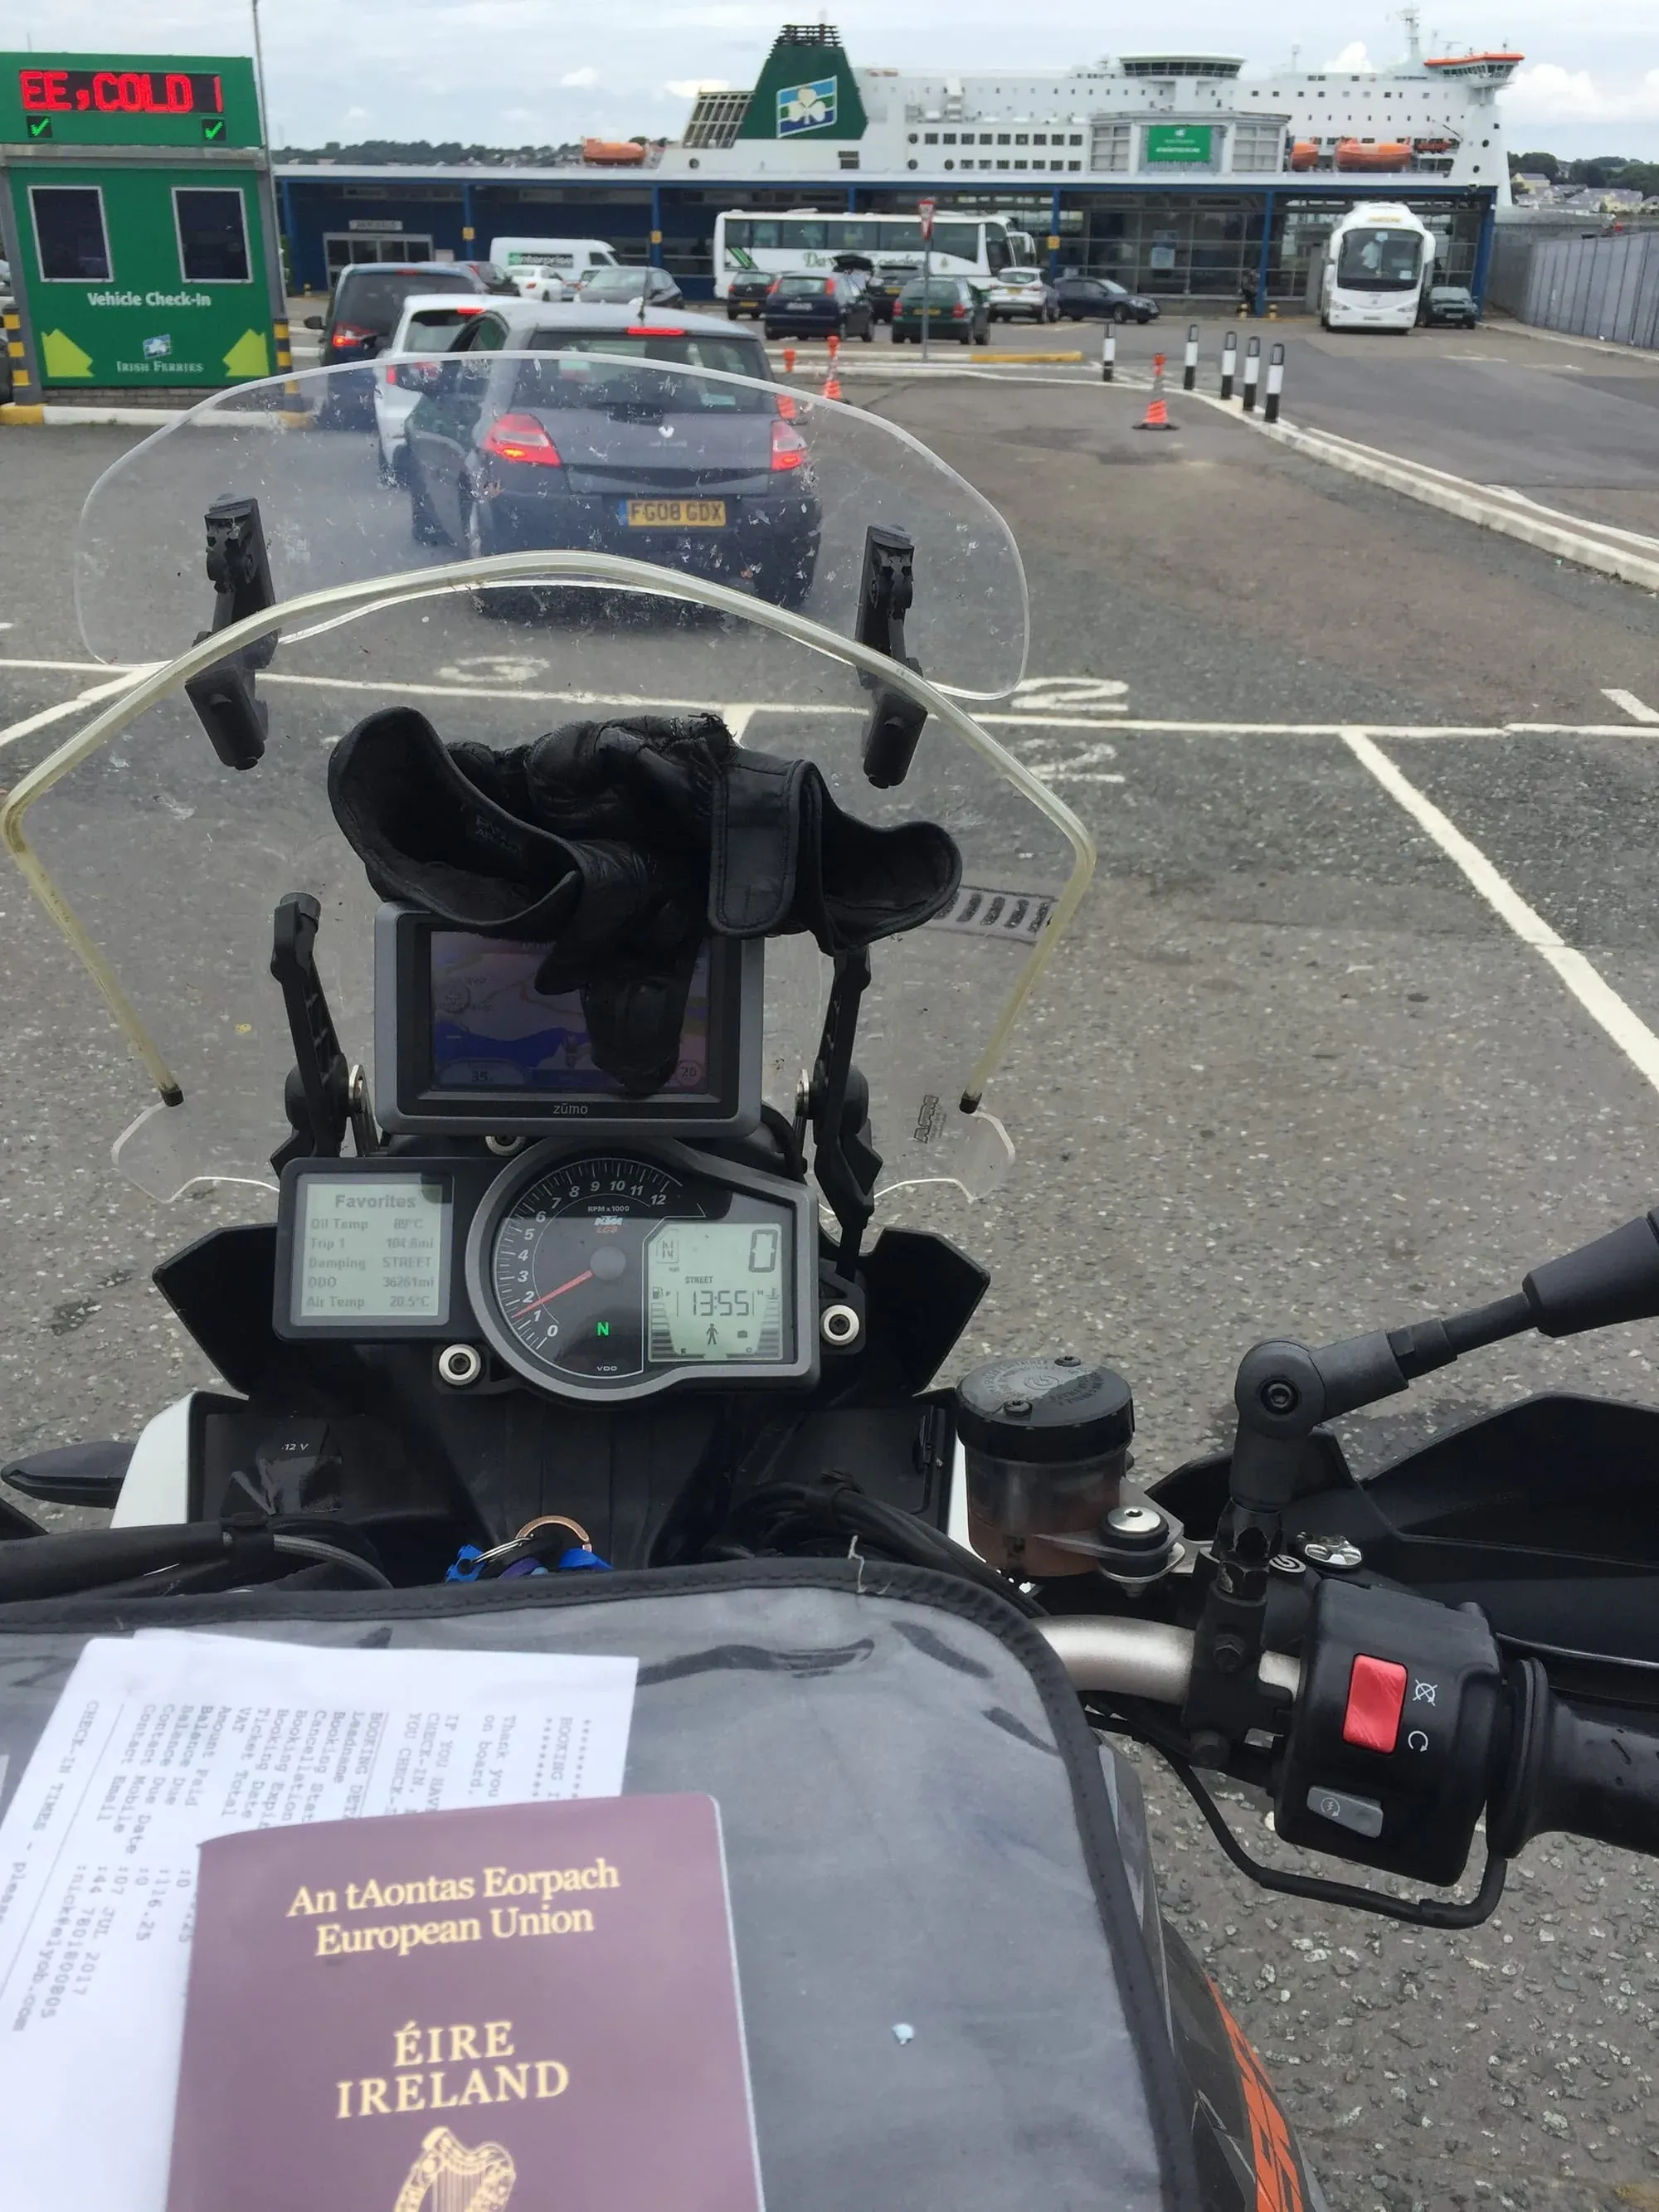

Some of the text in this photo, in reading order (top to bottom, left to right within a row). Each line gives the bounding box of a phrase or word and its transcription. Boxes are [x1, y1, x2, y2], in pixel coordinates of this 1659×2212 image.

[87, 291, 142, 306] Vehicle
[686, 503, 722, 522] GDX
[569, 1186, 580, 1198] 8
[591, 1181, 601, 1192] 9
[610, 1180, 625, 1192] 10
[630, 1184, 644, 1196] 11
[335, 1194, 416, 1208] Favorites
[551, 1197, 562, 1208] 7
[650, 1194, 667, 1206] 12
[310, 1218, 328, 1229] Oil
[333, 1218, 368, 1232] Temp
[536, 1211, 546, 1223] 6
[310, 1237, 334, 1251] Trip
[339, 1237, 345, 1248] 1
[524, 1228, 534, 1241] 5
[309, 1257, 432, 1271] Damping STREET
[518, 1250, 528, 1261] 4
[748, 1229, 778, 1272] 0
[308, 1276, 337, 1288] ODO
[518, 1271, 528, 1282] 3
[684, 1276, 713, 1284] STREET
[306, 1296, 325, 1308] Air
[331, 1296, 365, 1310] Temp
[523, 1291, 534, 1303] 2
[533, 1310, 542, 1322] 1
[597, 1321, 609, 1335] N
[547, 1325, 558, 1337] 0
[202, 1706, 232, 1758] Amount
[232, 1707, 252, 1733] VAT
[404, 1712, 421, 1739] YOU
[445, 1714, 459, 1731] IF
[481, 1714, 495, 1732] on
[58, 1699, 100, 1773] CHECK-IN
[121, 1704, 156, 1764] Contact
[140, 1704, 175, 1766] Contact
[160, 1705, 194, 1767] Balance
[179, 1705, 214, 1767] Balance
[275, 1709, 308, 1772] Booking
[314, 1711, 346, 1773] Booking
[355, 1711, 384, 1775] BOOKING
[221, 1708, 270, 1816] Ticket Total
[435, 1740, 454, 1767] YOU
[489, 1715, 517, 1798] Thank you
[551, 1716, 573, 1781] BOOKING
[241, 1709, 289, 1819] Booking Date
[281, 1710, 327, 1821] Cancellation
[97, 1775, 127, 1821] Email
[145, 1777, 166, 1804] Due
[164, 1777, 186, 1806] Due
[184, 1769, 210, 1806] Paid
[32, 1783, 64, 1831] TIMES
[114, 1775, 147, 1834] Mobile
[126, 1815, 152, 1854] Date
[285, 1858, 620, 1917] An tAontas Eorpach
[314, 1904, 596, 1956] European Union
[73, 1952, 101, 1996] 2017
[393, 2020, 514, 2067] ÉIRE
[335, 2060, 570, 2119] IRELAND
